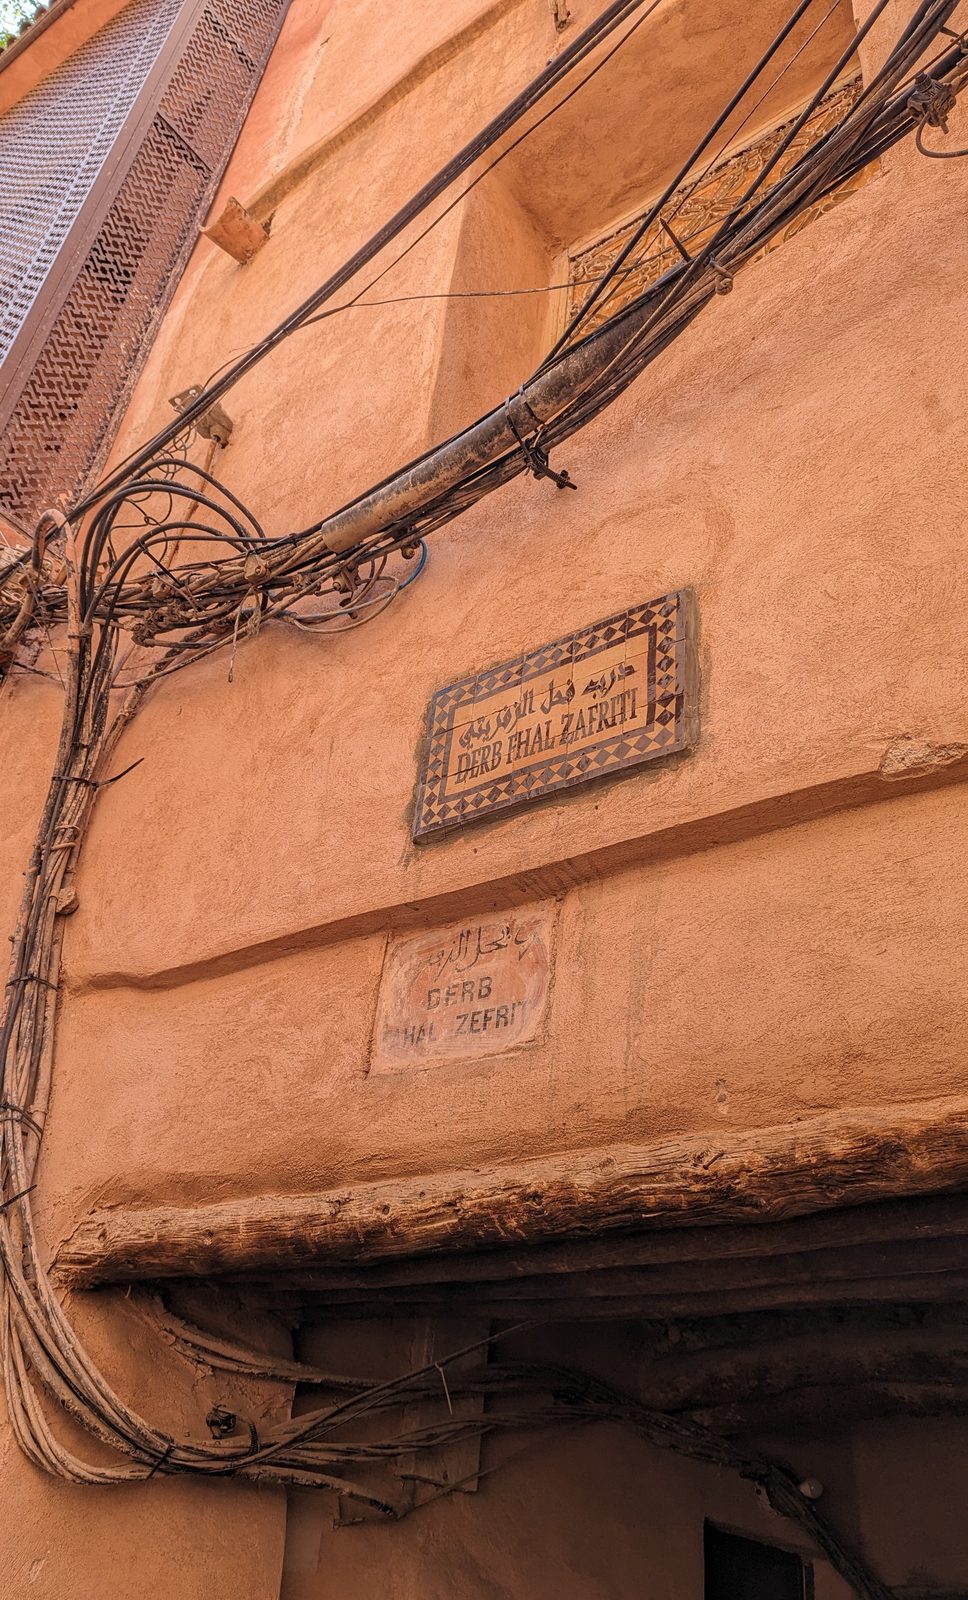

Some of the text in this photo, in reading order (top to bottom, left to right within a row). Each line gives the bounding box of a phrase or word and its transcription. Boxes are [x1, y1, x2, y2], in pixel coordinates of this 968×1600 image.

[540, 678, 571, 715] فحل
[580, 664, 637, 700] درب
[454, 687, 639, 785] DERB FHAL ZAFRITI
[426, 976, 493, 1011] DERB
